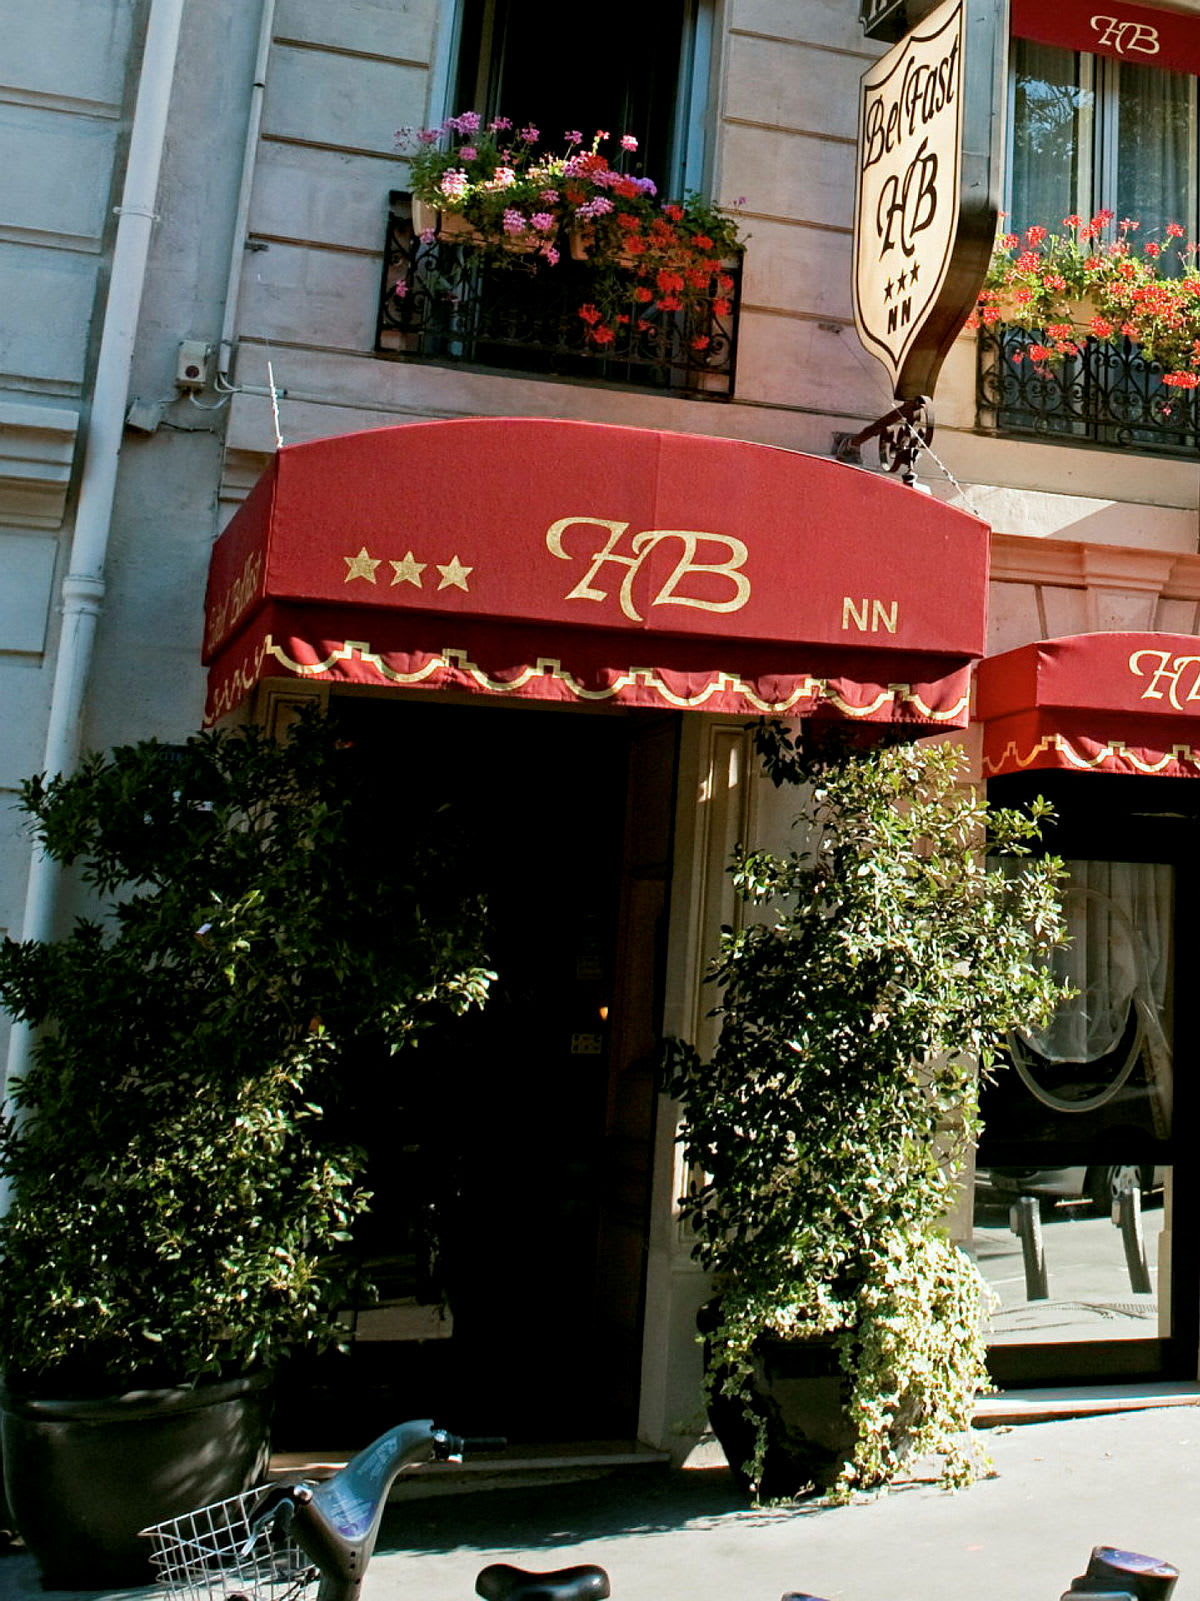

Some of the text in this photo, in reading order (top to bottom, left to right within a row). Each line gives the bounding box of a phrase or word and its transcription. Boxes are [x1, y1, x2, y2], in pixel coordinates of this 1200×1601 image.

[1090, 16, 1160, 54] HB
[876, 137, 938, 258] HB
[887, 298, 912, 334] NN
[545, 516, 751, 622] HB
[842, 597, 898, 634] NN
